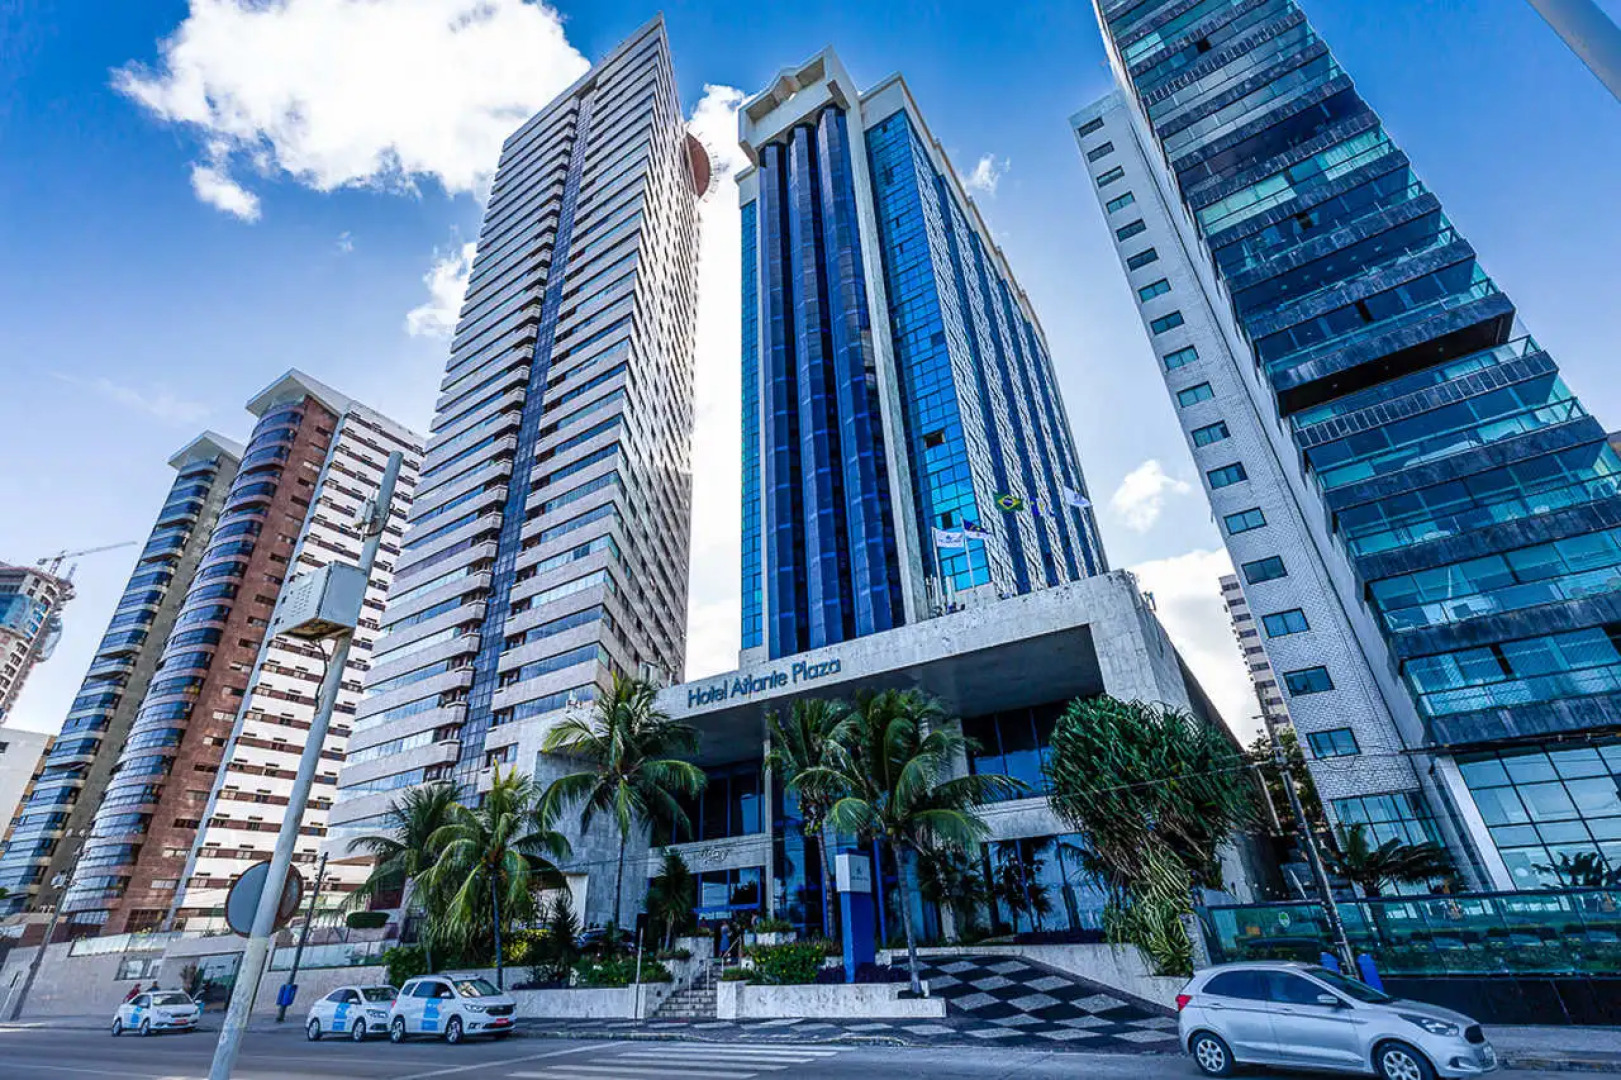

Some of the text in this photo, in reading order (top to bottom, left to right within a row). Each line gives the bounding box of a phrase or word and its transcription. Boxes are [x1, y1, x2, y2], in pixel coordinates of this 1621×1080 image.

[688, 658, 842, 708] Hotel Atlante Plaza
